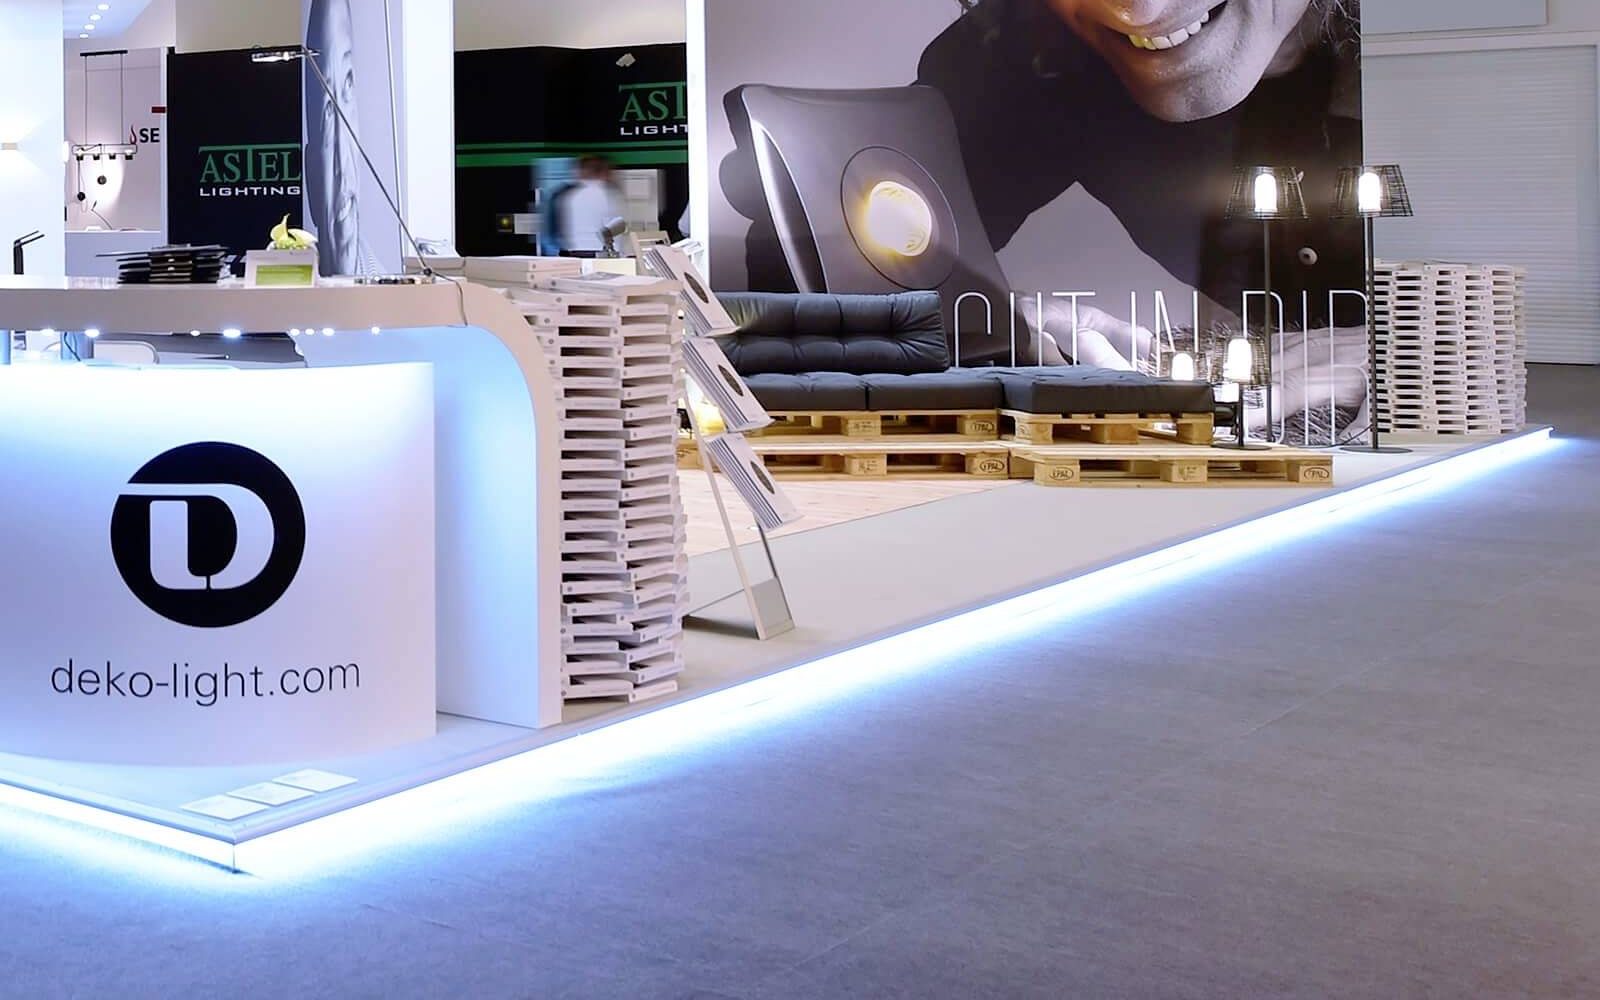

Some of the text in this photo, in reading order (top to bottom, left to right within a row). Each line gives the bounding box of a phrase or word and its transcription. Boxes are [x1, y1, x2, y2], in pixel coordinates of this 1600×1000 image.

[199, 143, 302, 183] ASTEL
[200, 186, 301, 197] LIGHTING
[51, 658, 360, 707] deko-light.com
